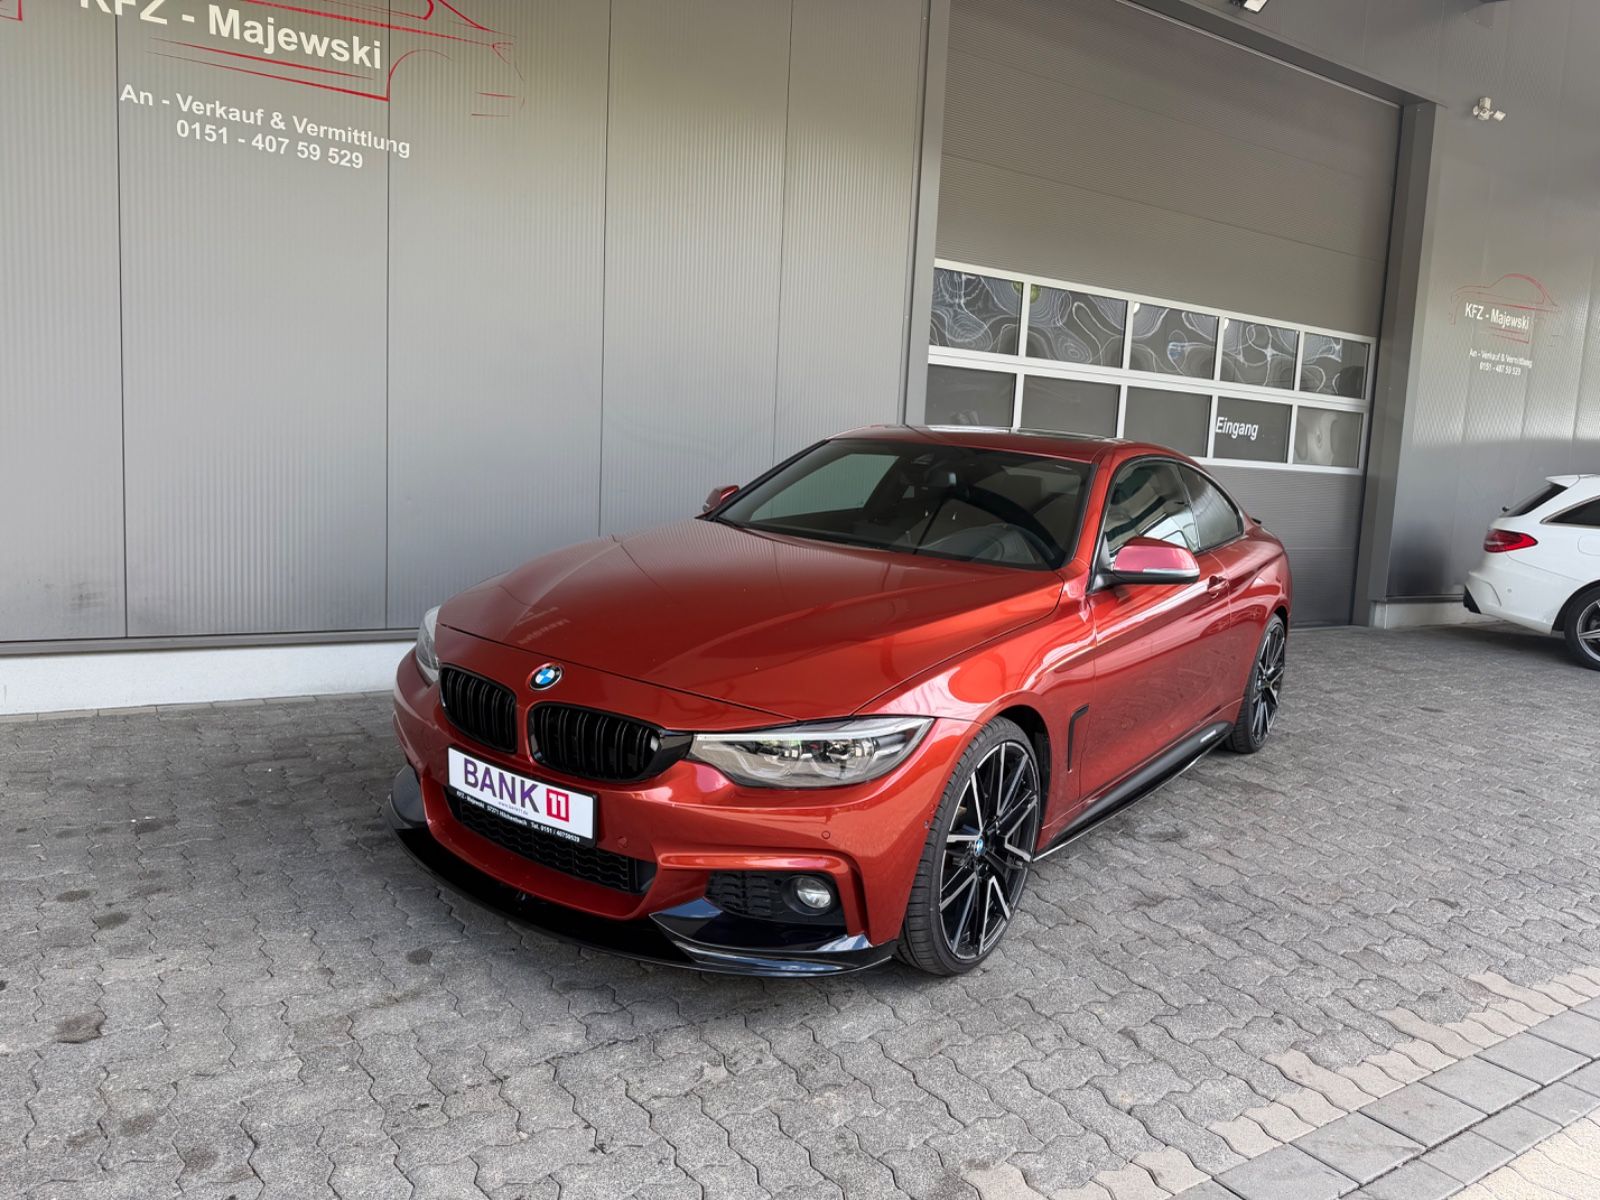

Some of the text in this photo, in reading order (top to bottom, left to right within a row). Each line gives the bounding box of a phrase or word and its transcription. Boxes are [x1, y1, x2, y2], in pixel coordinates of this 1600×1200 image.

[182, 14, 195, 23] -
[208, 4, 381, 69] Majewski
[120, 84, 153, 106] An
[176, 93, 264, 125] Verkauf
[270, 111, 286, 130] &
[292, 115, 410, 158] Vermittlung
[176, 119, 228, 144] 0151
[251, 133, 290, 154] 407
[297, 141, 321, 161] 59
[327, 147, 363, 169] 529
[1464, 302, 1484, 320] KFZ
[1490, 308, 1530, 330] Majewski
[1216, 416, 1259, 441] Eingang
[464, 757, 567, 819] BANK 11
